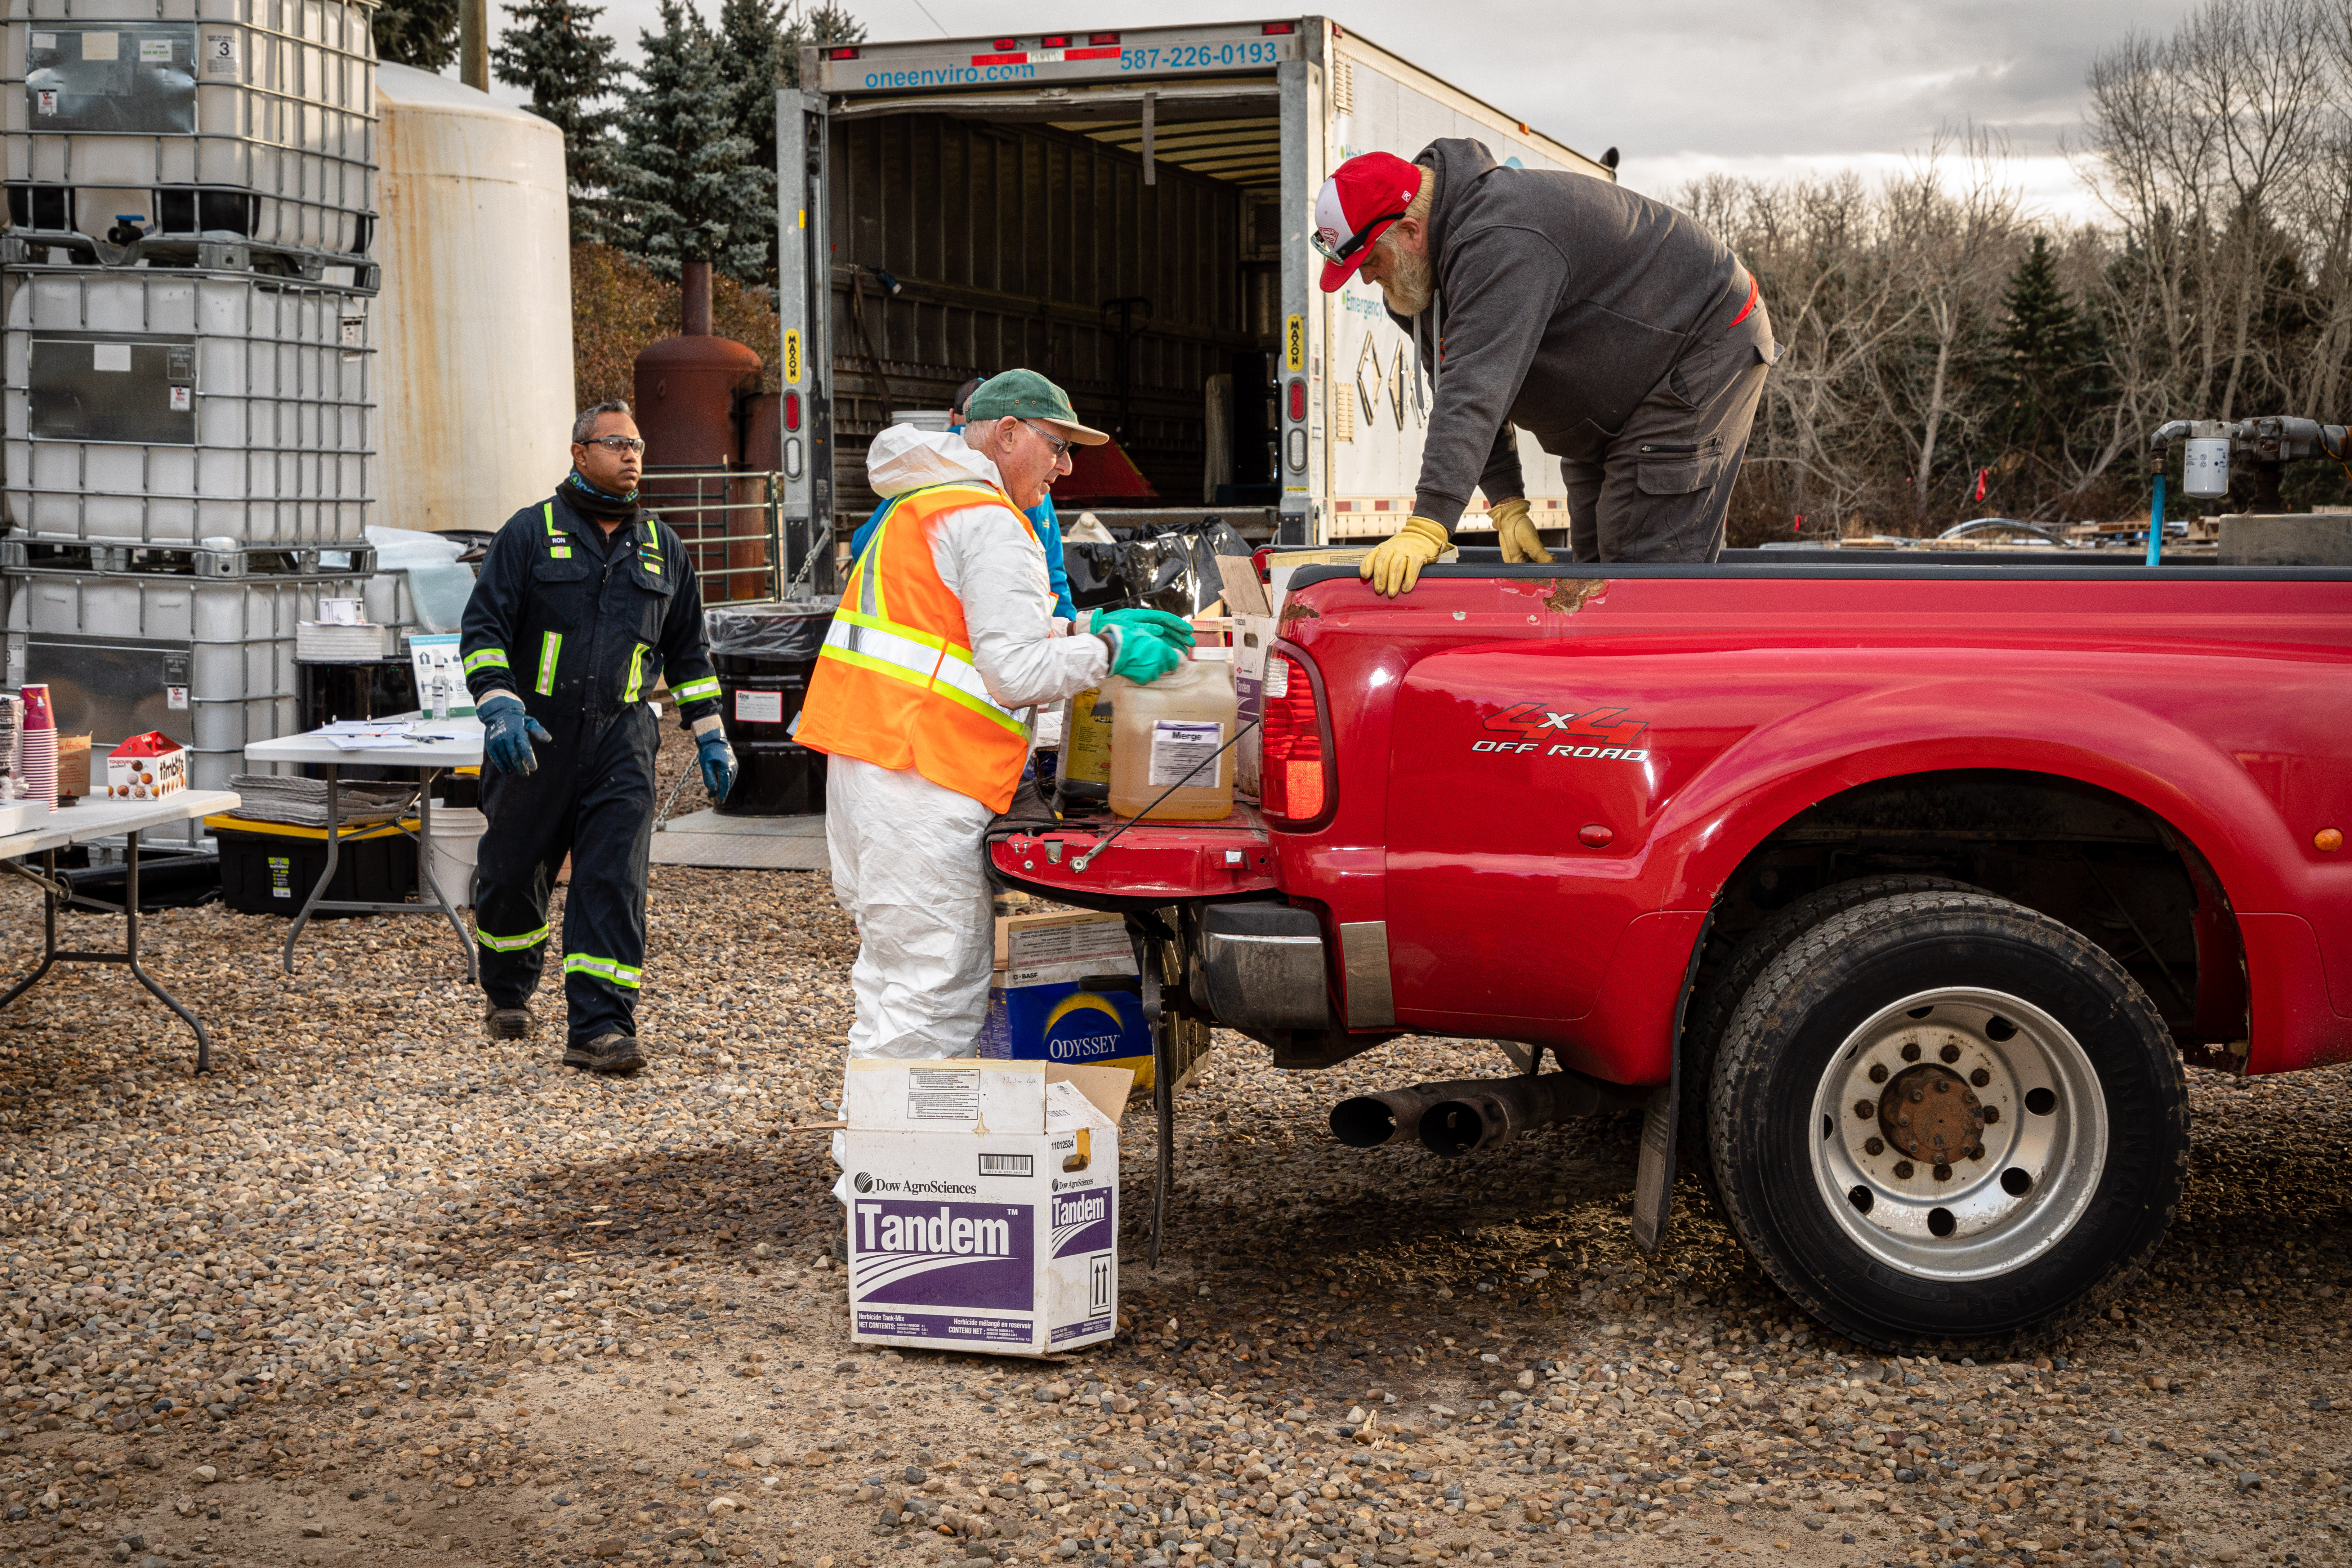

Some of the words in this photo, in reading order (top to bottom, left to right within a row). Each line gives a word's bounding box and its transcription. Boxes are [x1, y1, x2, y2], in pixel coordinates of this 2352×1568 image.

[219, 42, 229, 55] 3
[1121, 42, 1276, 70] 587-226-0193
[866, 63, 1035, 88] oneenviro.com
[1346, 289, 1383, 322] Emergency
[1291, 321, 1299, 365] MAXON
[1483, 702, 1650, 745] 4x4
[1172, 732, 1202, 741] Merge
[1472, 740, 1539, 754] OFF
[1546, 745, 1650, 761] ROAD
[160, 754, 183, 780] timbits
[1052, 1140, 1074, 1150] 11012534
[876, 1180, 901, 1192] Dow
[903, 1180, 976, 1194] AgroSciences
[1069, 1179, 1093, 1189] AgroSciences
[1053, 1194, 1104, 1226] Tandem
[858, 1204, 1009, 1255] Tandem
[978, 1320, 1000, 1328] mélangé
